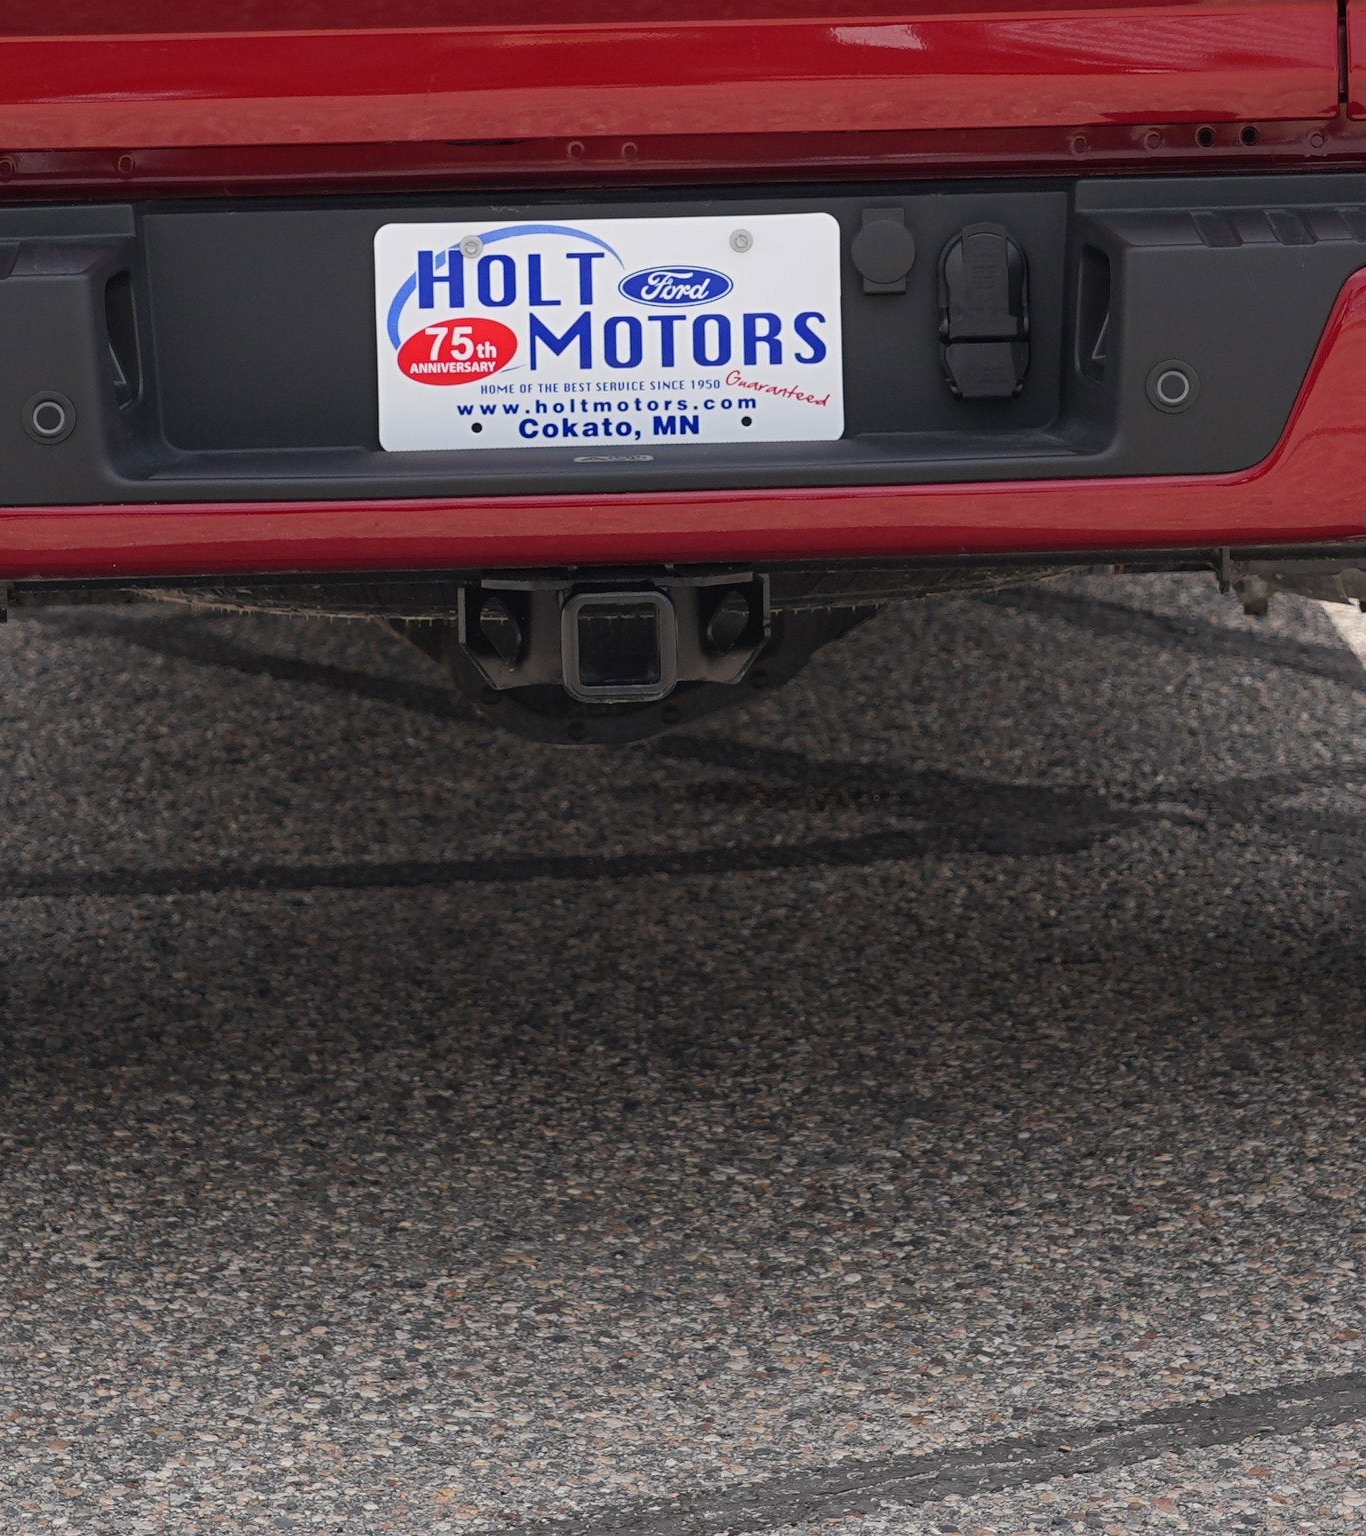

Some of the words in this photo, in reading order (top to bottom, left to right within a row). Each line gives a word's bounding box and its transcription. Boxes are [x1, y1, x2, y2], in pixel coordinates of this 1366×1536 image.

[418, 250, 605, 309] HOLT
[641, 271, 711, 301] Ford
[425, 326, 497, 362] 75th
[530, 311, 828, 371] MOTORS
[410, 360, 496, 376] ANNIVERSARY
[480, 384, 515, 395] HOME
[520, 383, 533, 394] OF
[539, 382, 559, 393] THE
[564, 382, 591, 393] BEST
[596, 381, 645, 392] SERVICE
[650, 380, 685, 390] SINCE
[690, 379, 721, 390] 1950
[725, 369, 831, 407] Guaranteed
[457, 396, 757, 416] www.holtmotors.com
[518, 417, 641, 441] Cokato,
[653, 414, 700, 436] MN
